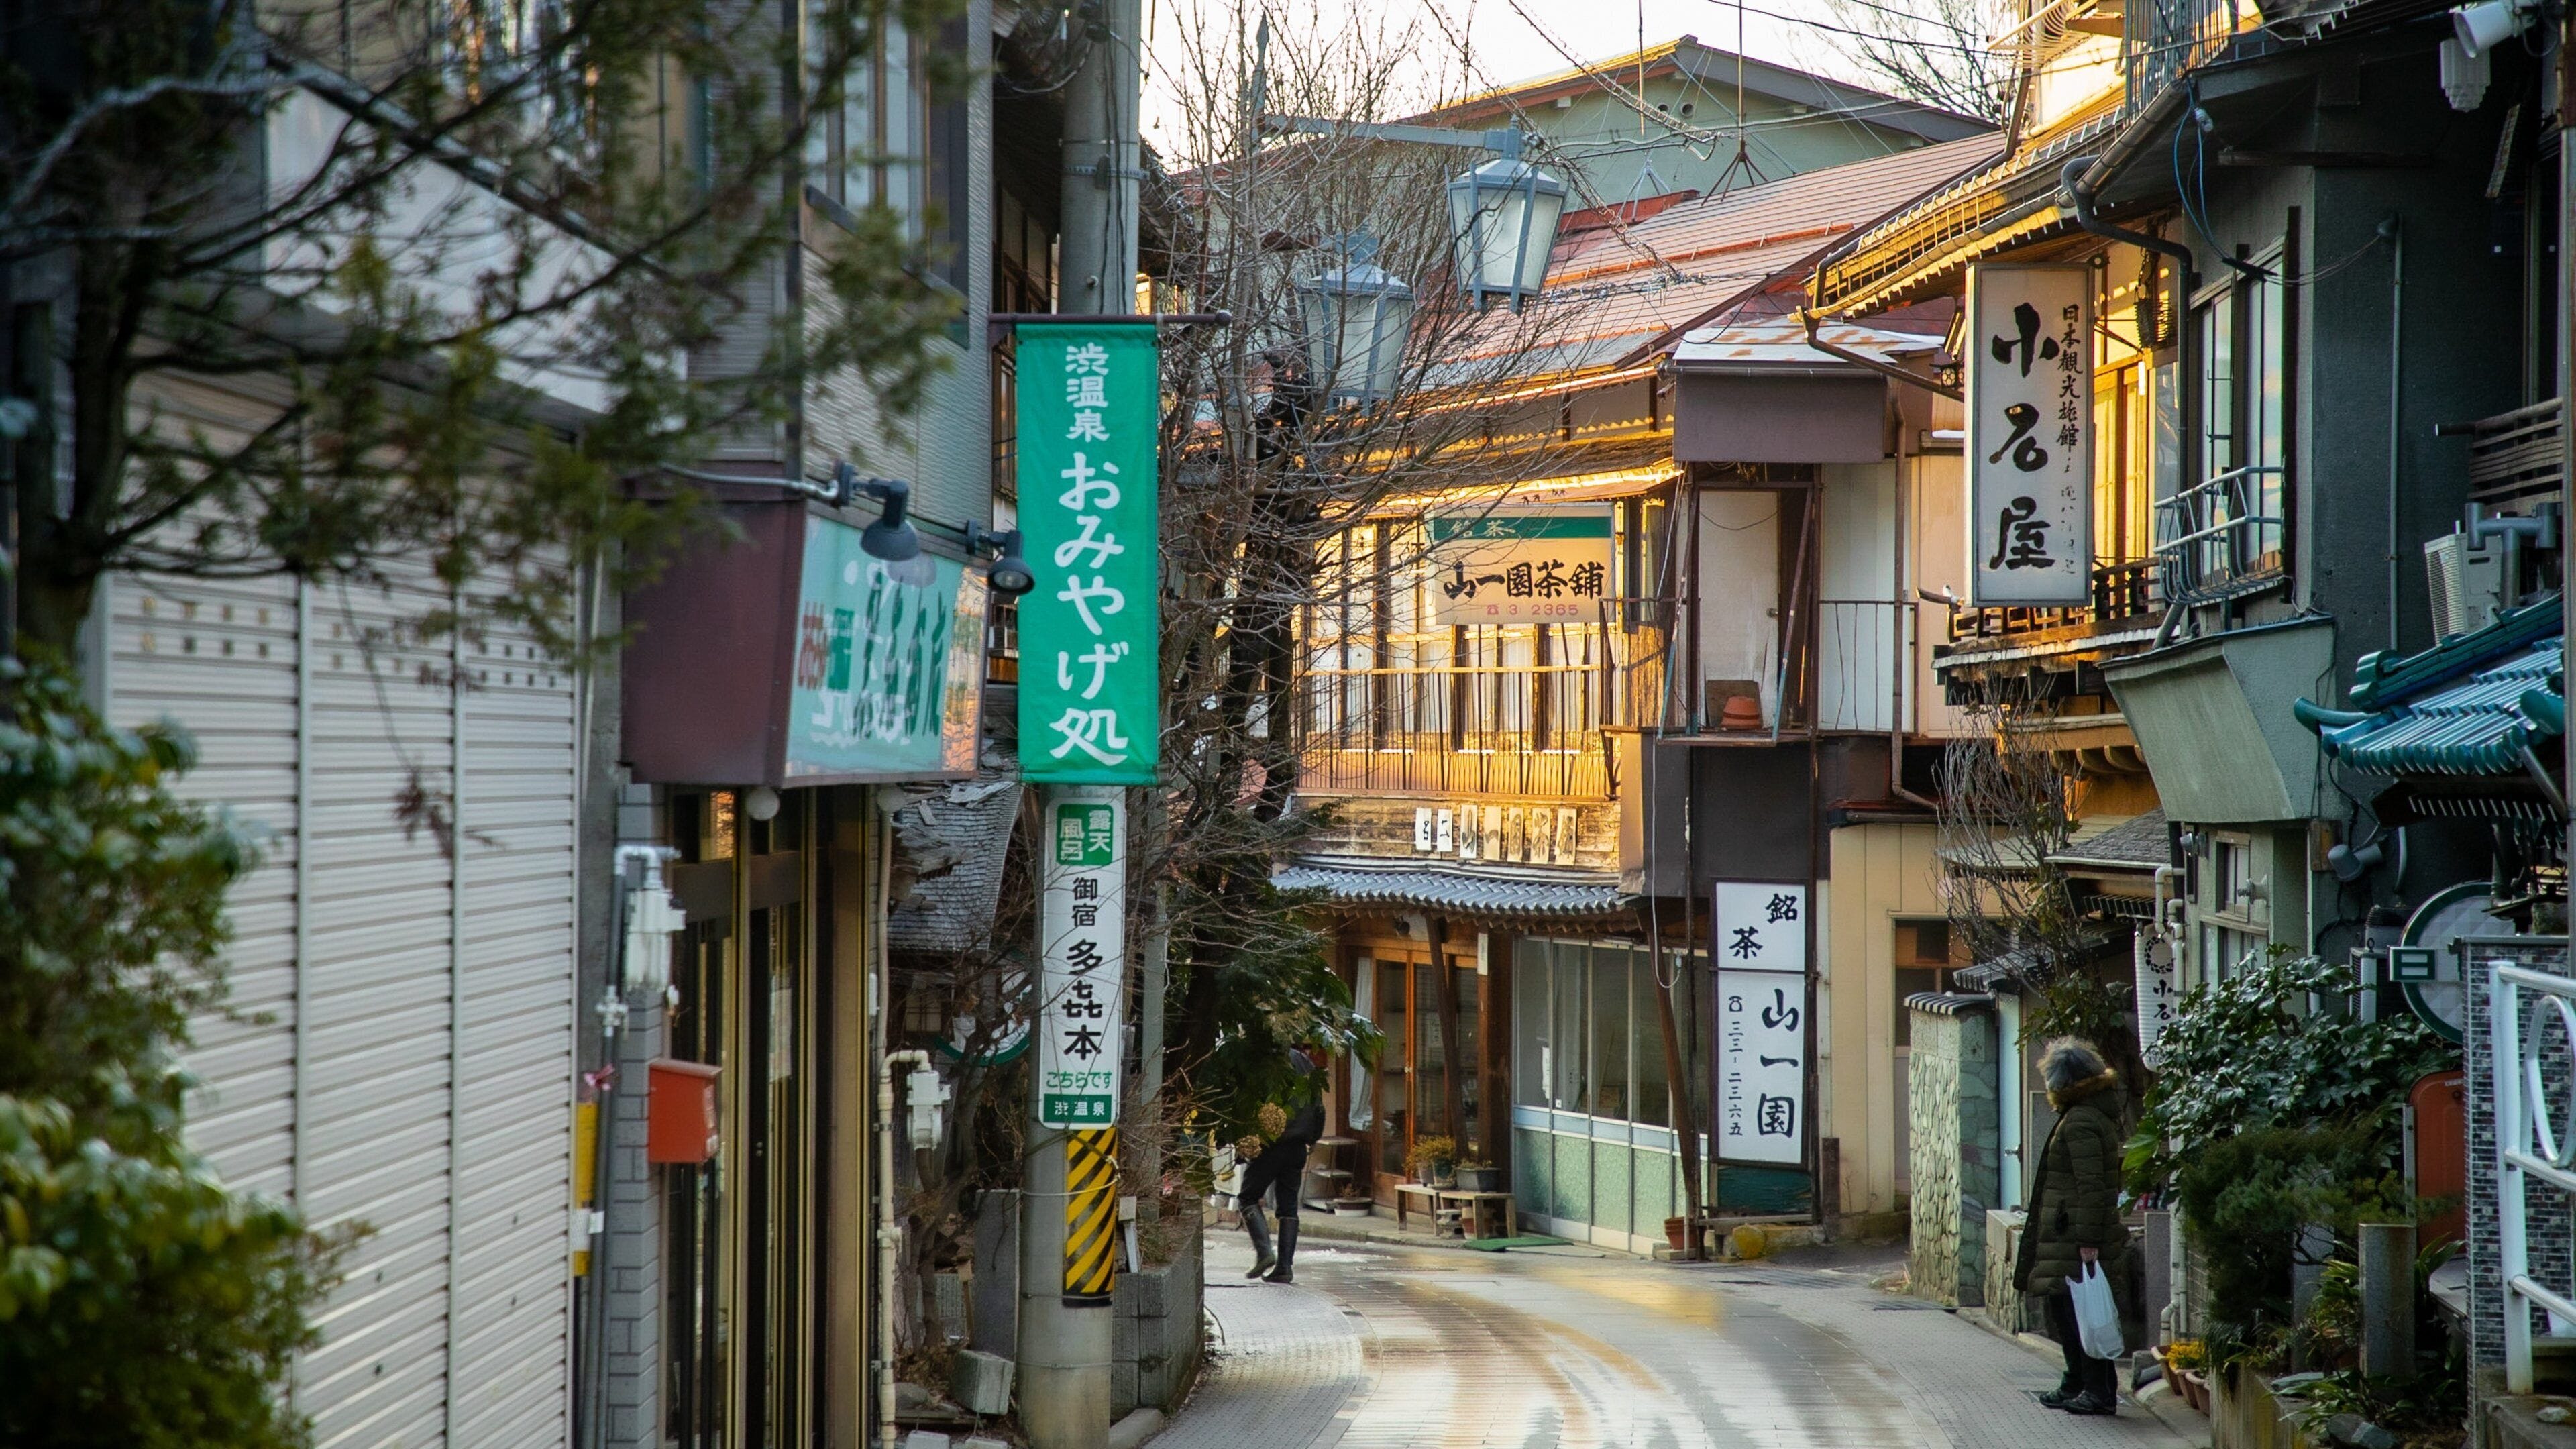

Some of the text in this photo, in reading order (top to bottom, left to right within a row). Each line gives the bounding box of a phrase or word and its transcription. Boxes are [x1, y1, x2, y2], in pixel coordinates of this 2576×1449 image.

[1065, 342, 1110, 443] 渋温泉
[1989, 302, 2060, 570] 小石屋
[1049, 451, 1129, 767] おみやげ処
[1530, 603, 1579, 616] 2365
[1060, 818, 1085, 861] 風呂
[1088, 810, 1111, 853] 露天
[1071, 877, 1098, 928] 御宿
[1046, 1071, 1113, 1089] こちらです
[1756, 988, 1799, 1138] 山一園
[1054, 1100, 1105, 1117] 渋温泉
